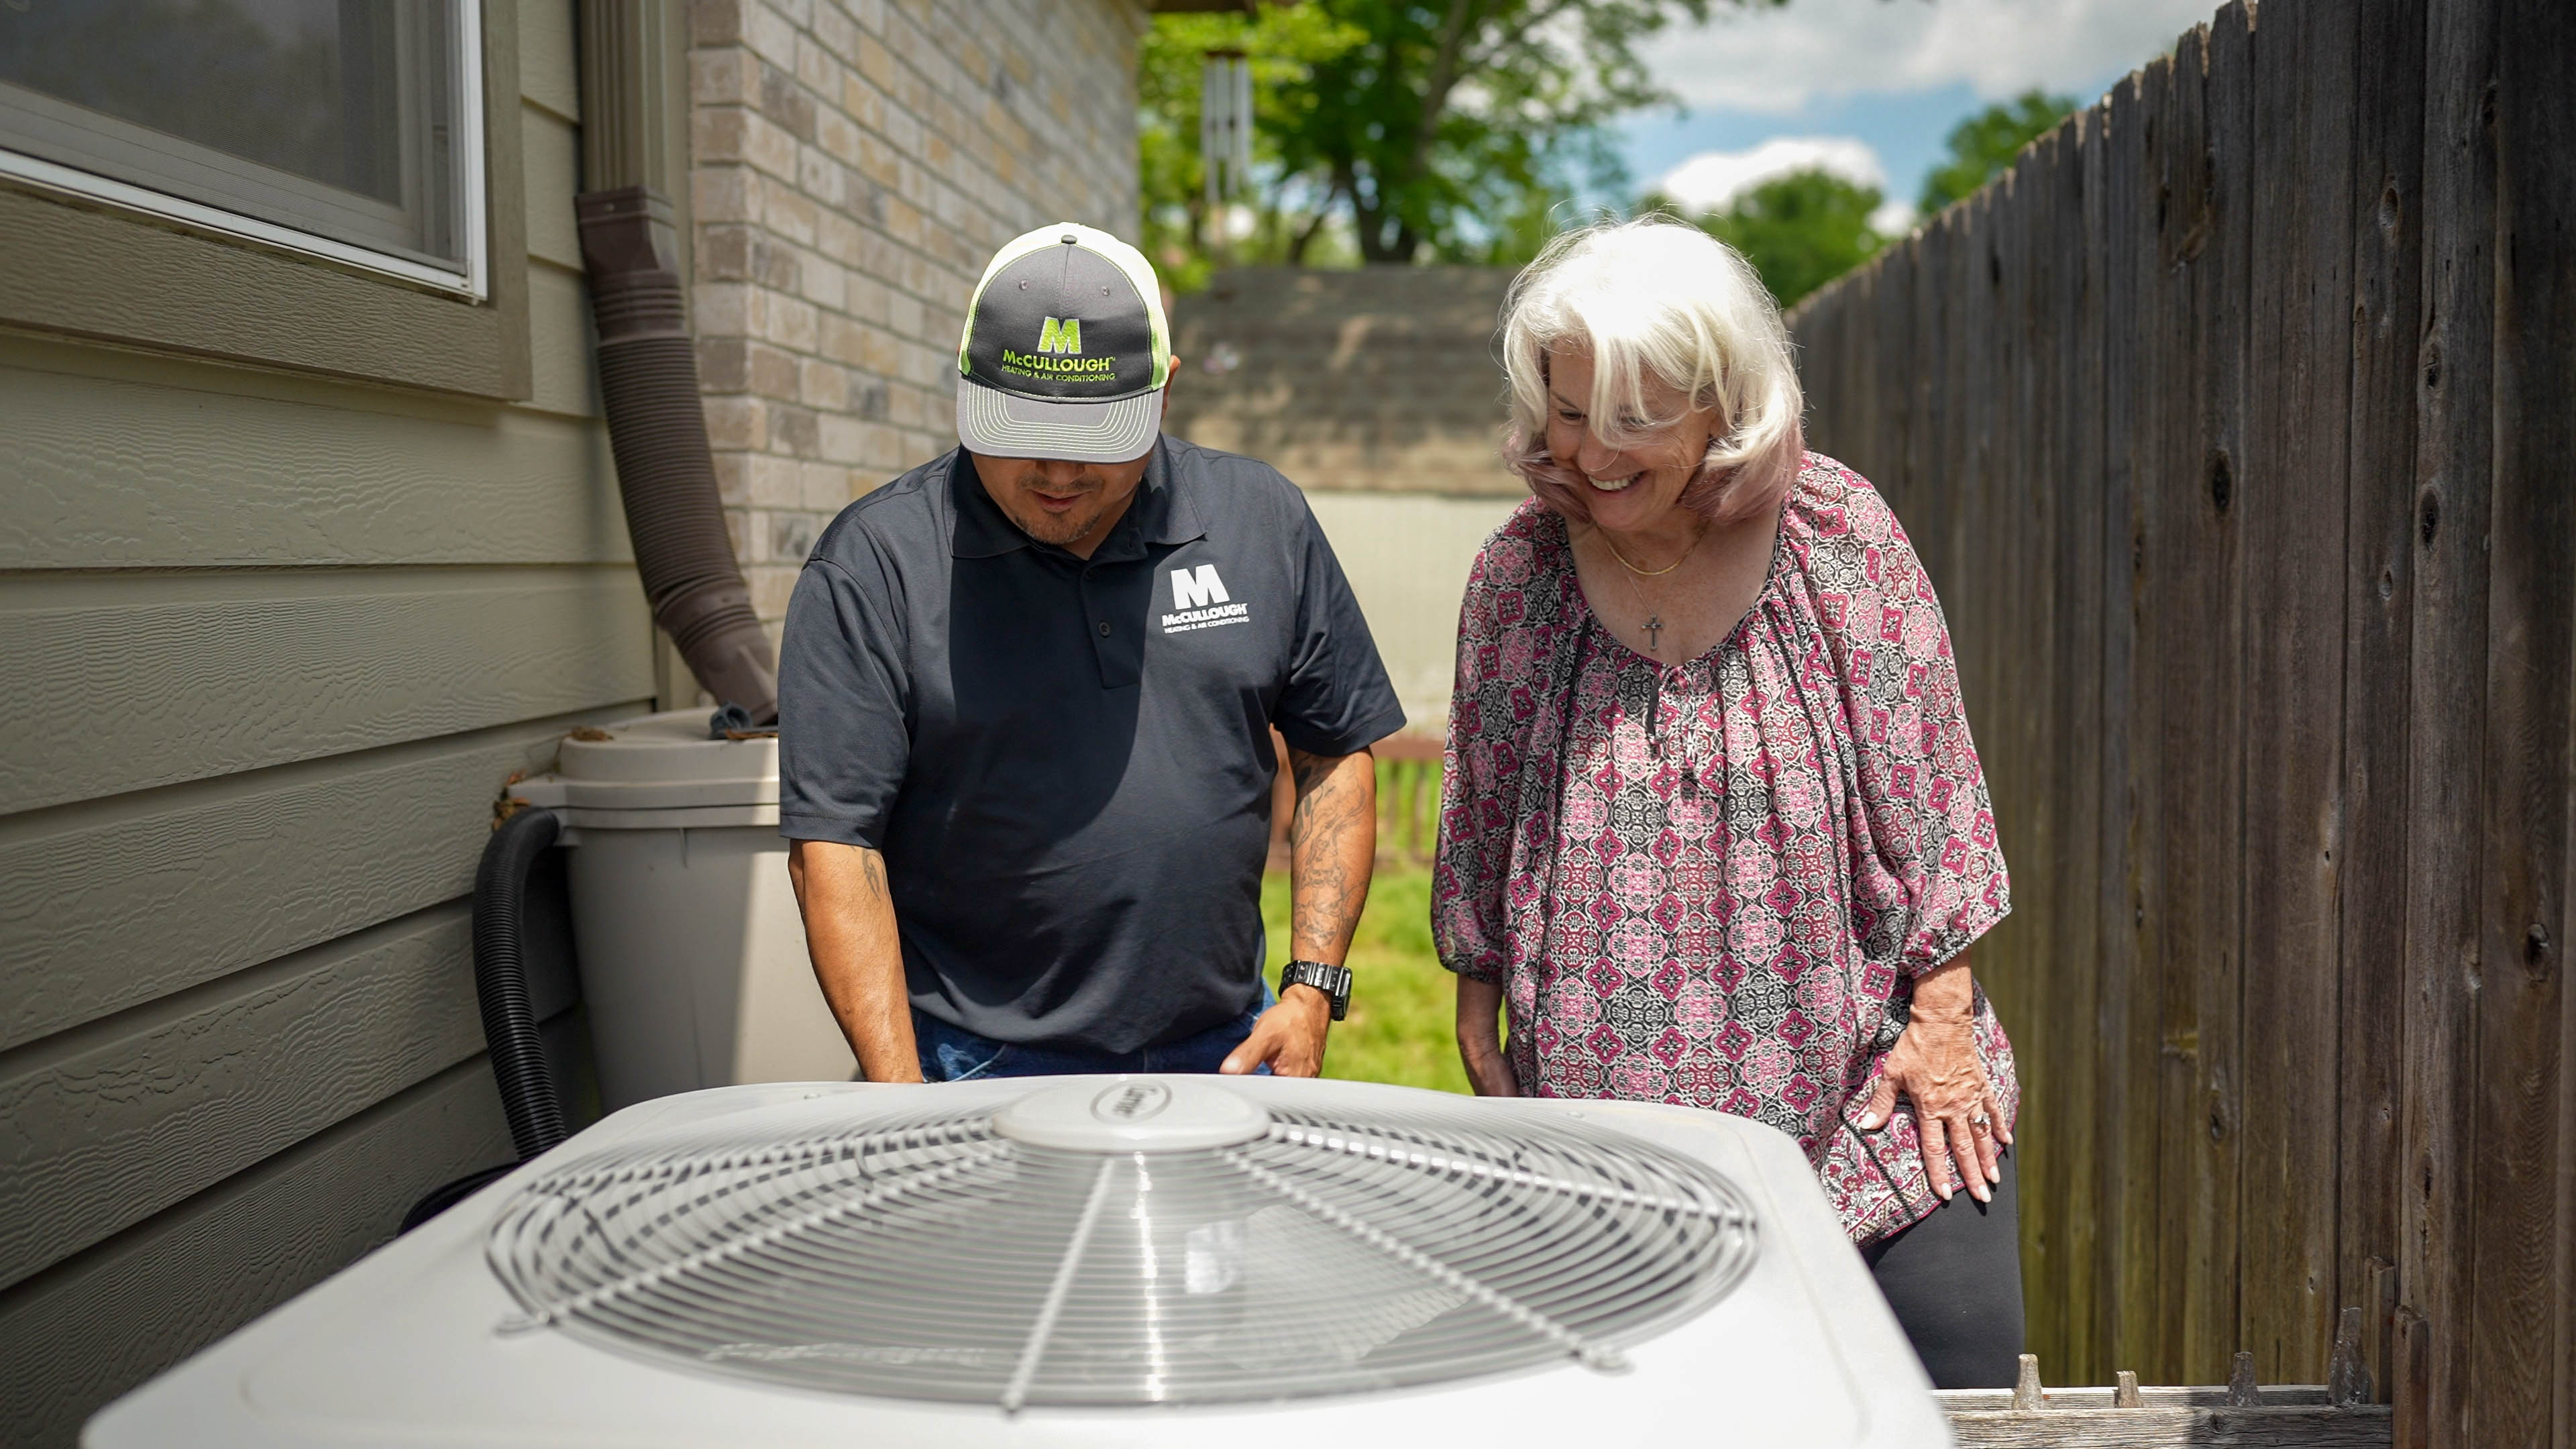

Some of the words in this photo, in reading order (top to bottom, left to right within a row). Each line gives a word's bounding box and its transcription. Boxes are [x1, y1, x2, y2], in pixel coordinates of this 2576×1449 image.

[1037, 316, 1082, 355] M
[1002, 364, 1032, 377] HEATING
[1033, 371, 1040, 379] &
[1040, 372, 1053, 380] AIR
[1055, 372, 1116, 382] CONDITIONING
[1171, 564, 1230, 610] M
